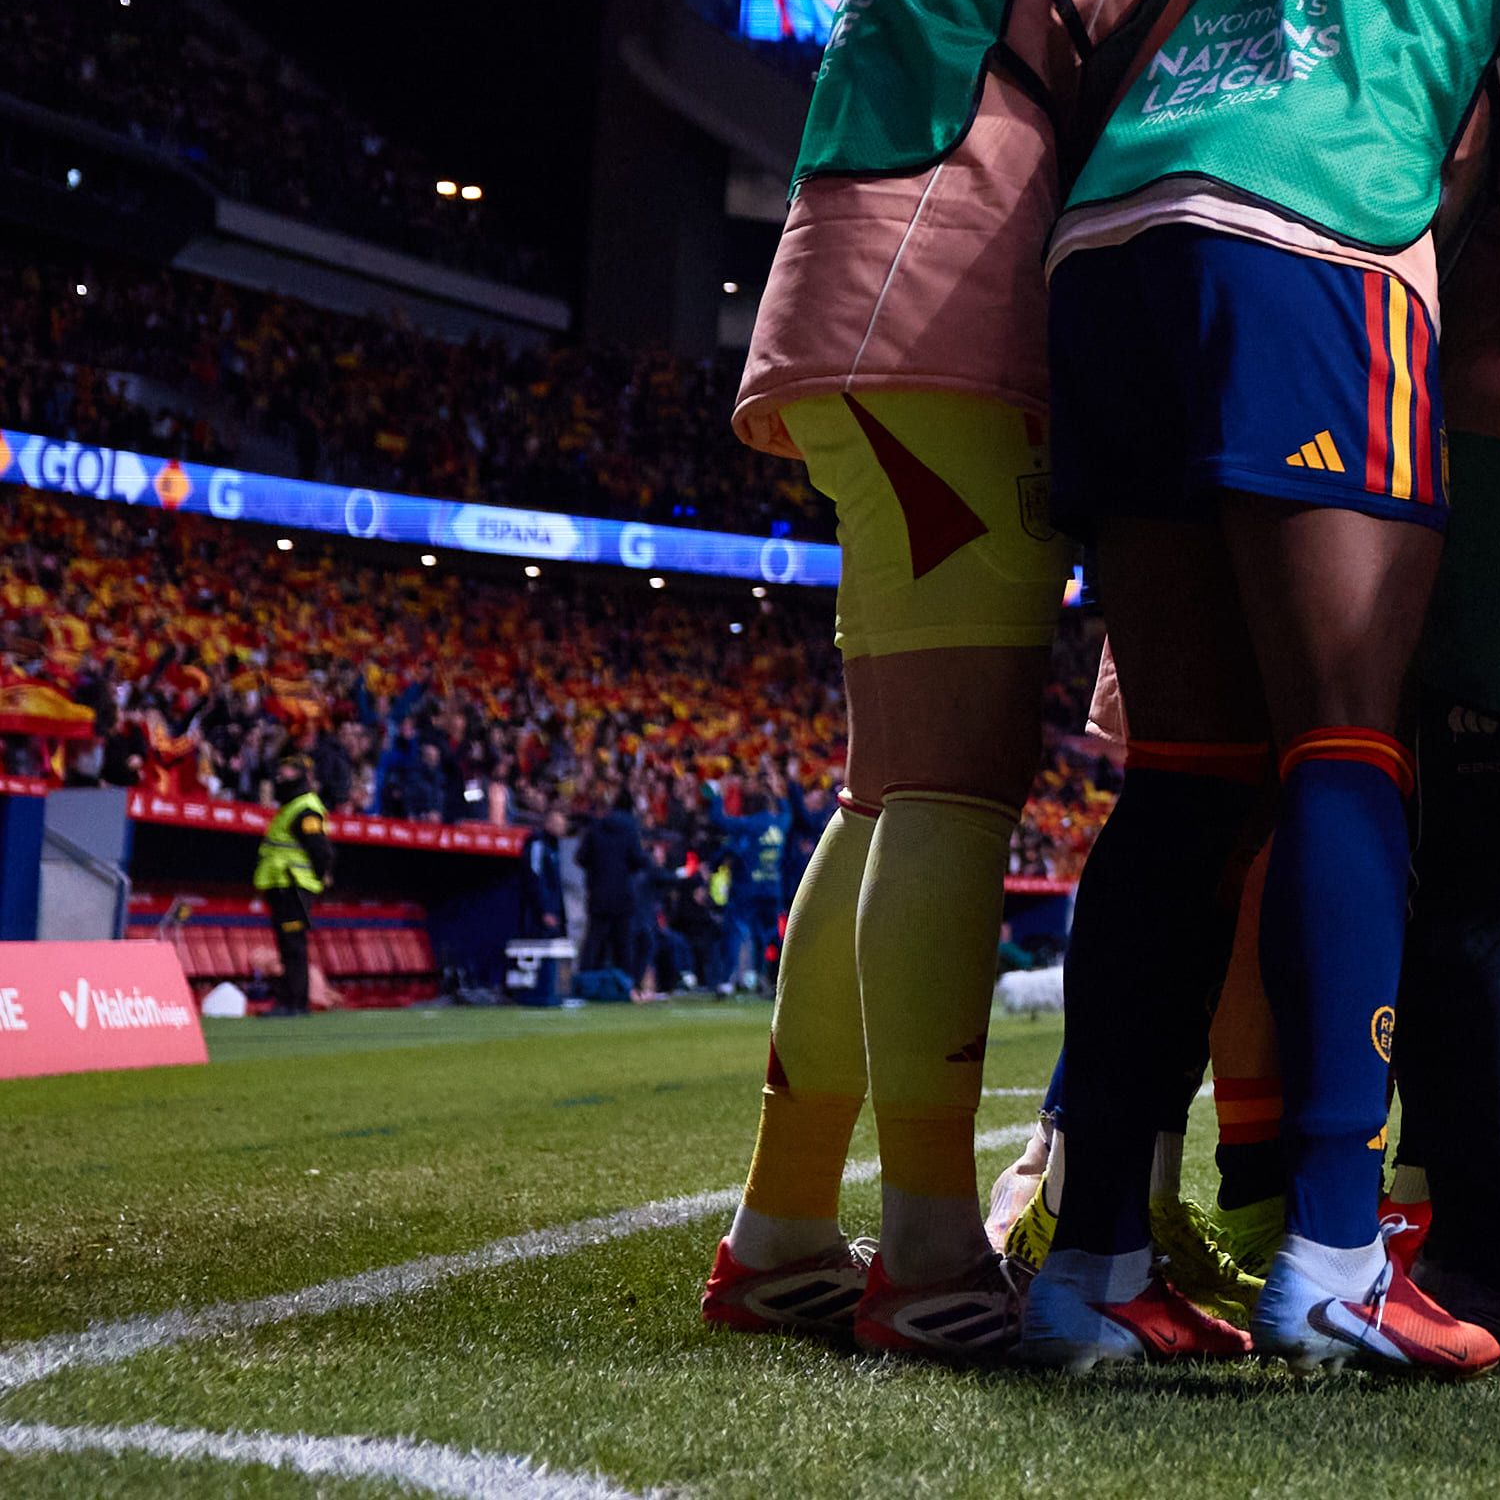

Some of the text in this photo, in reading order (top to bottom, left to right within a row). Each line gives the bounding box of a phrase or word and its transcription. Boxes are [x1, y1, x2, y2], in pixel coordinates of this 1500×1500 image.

[1146, 23, 1341, 82] NATIONS
[1141, 50, 1319, 115] LEAGUE
[1138, 86, 1282, 130] FINAL 2025
[476, 514, 551, 546] ESPAÑA
[92, 986, 160, 1030] Halcón
